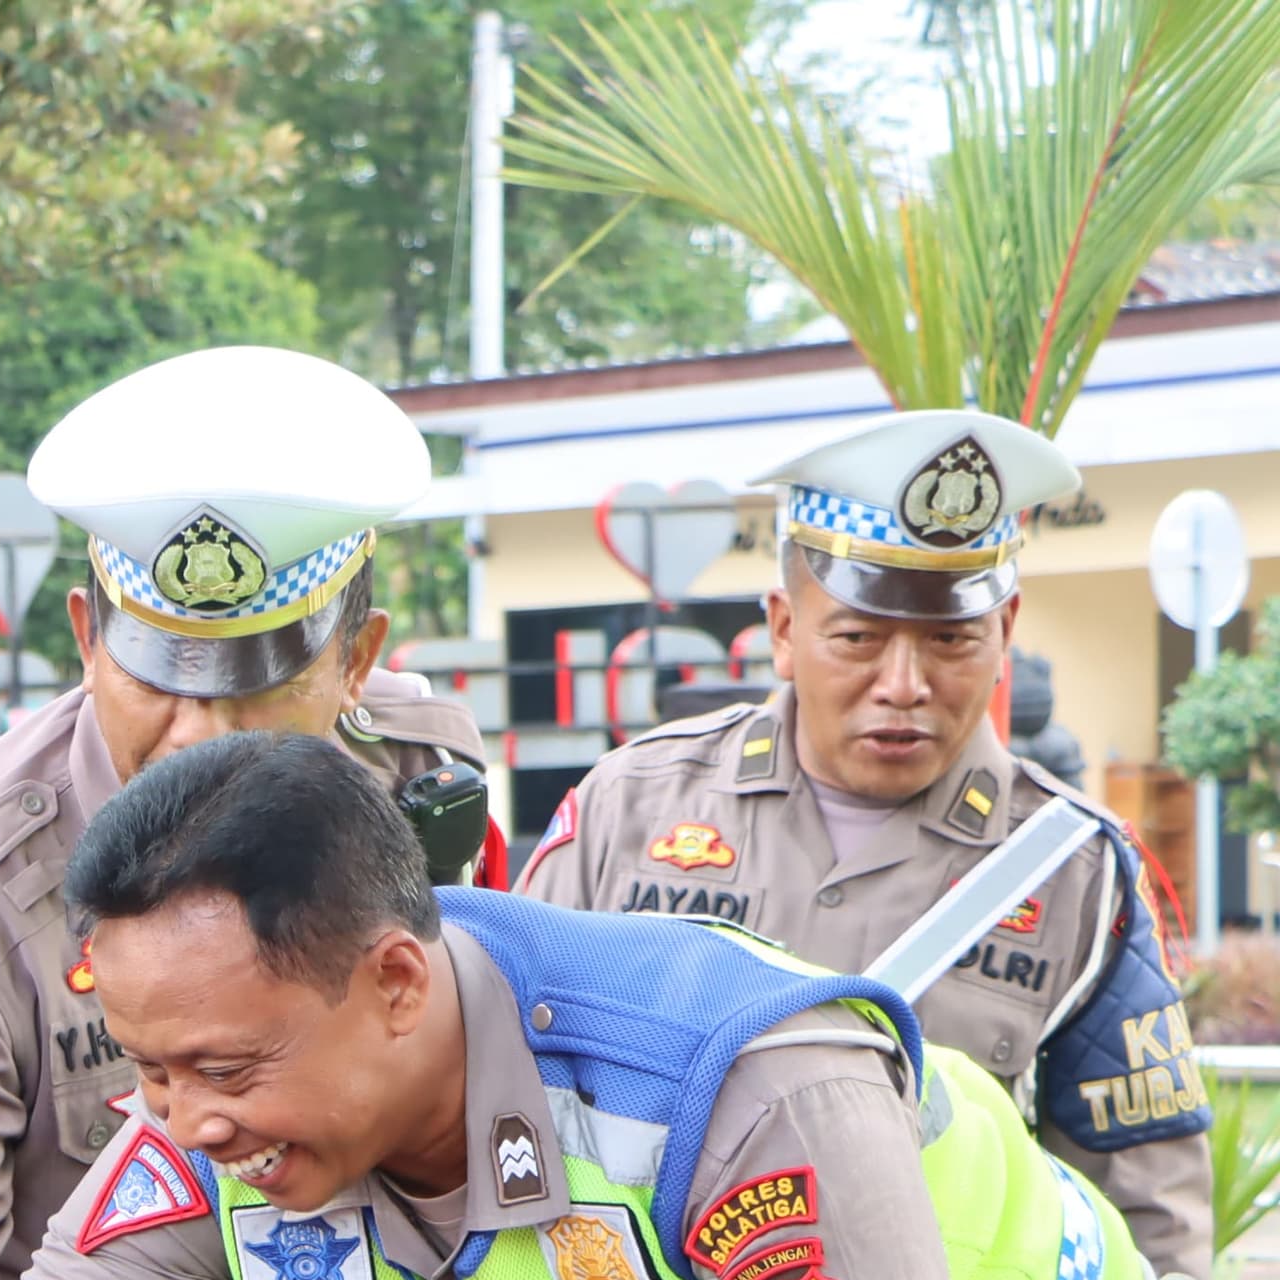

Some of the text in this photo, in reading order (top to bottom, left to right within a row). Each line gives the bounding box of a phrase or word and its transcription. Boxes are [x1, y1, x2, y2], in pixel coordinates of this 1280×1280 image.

[622, 880, 749, 926] JAYADI
[698, 1177, 794, 1247] POLRES
[710, 1195, 807, 1265] SALATIGA
